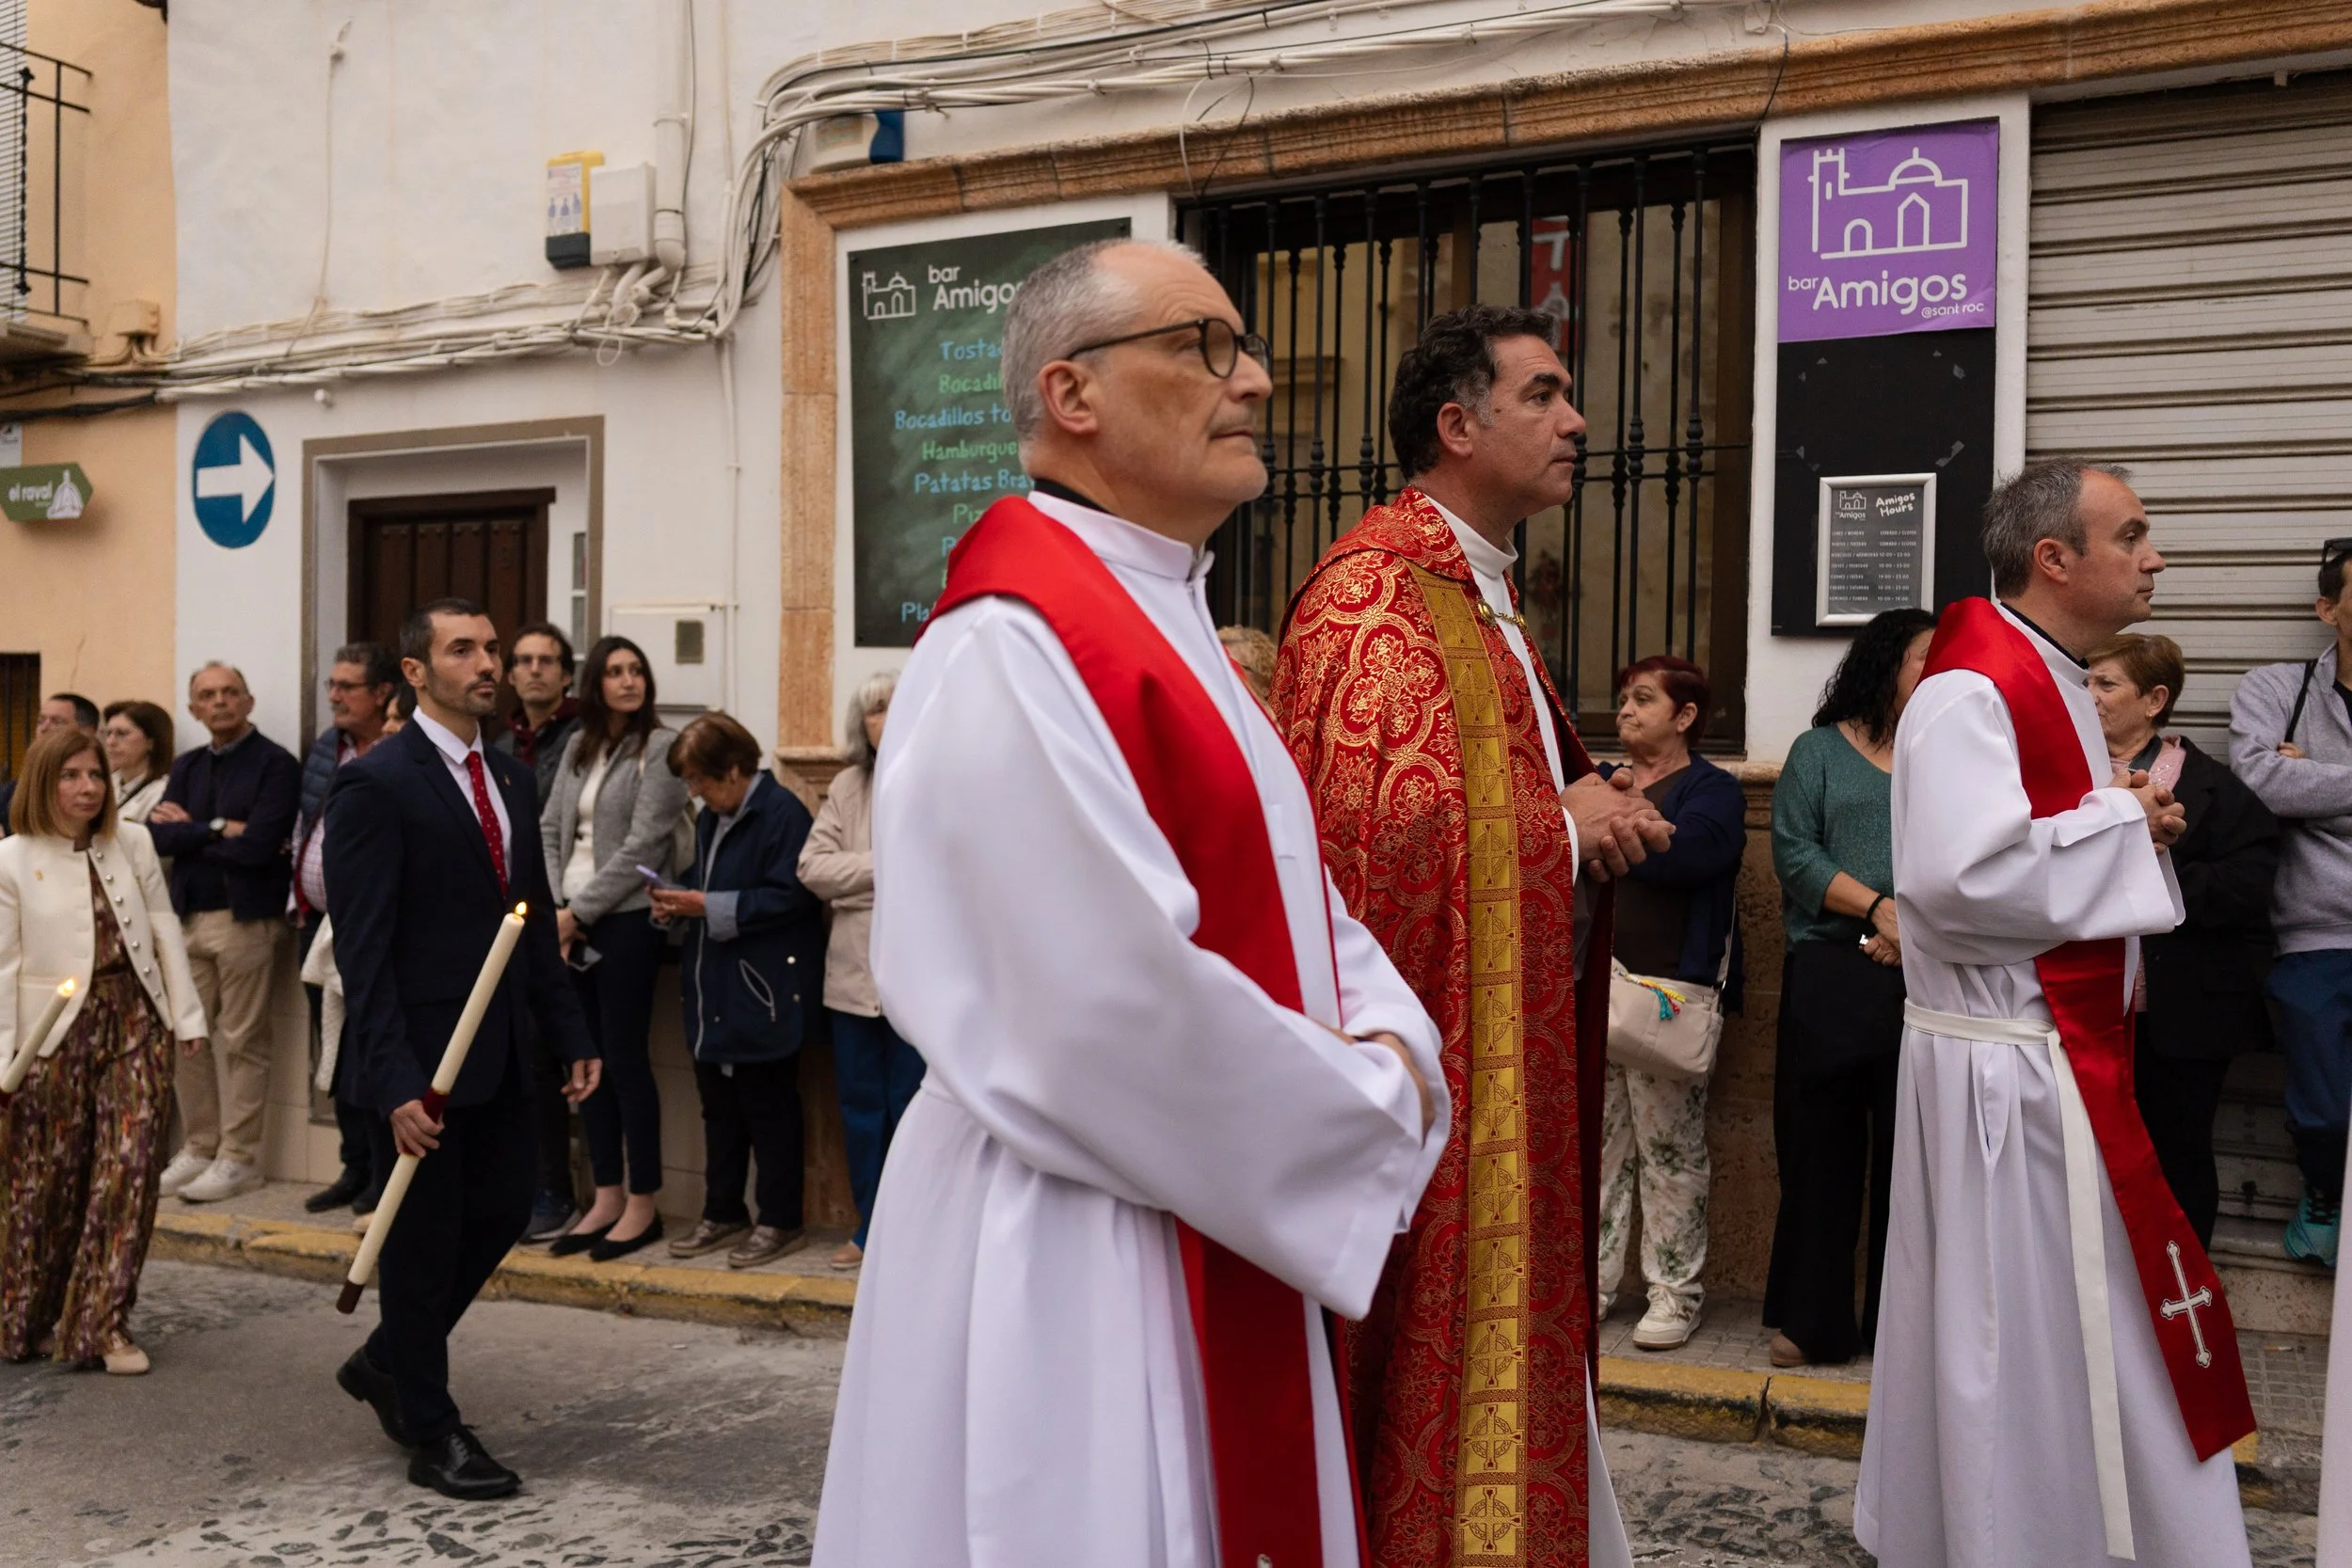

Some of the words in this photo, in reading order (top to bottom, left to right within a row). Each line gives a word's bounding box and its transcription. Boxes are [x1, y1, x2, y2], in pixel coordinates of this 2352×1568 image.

[928, 264, 961, 284] bar
[1788, 276, 1819, 292] bar
[1812, 270, 1967, 315] Amigos
[1962, 302, 1984, 313] roc
[895, 405, 985, 430] Bocadillos
[914, 470, 993, 495] Patatas
[1876, 492, 1915, 508] Amigos
[1880, 502, 1914, 517] Hours
